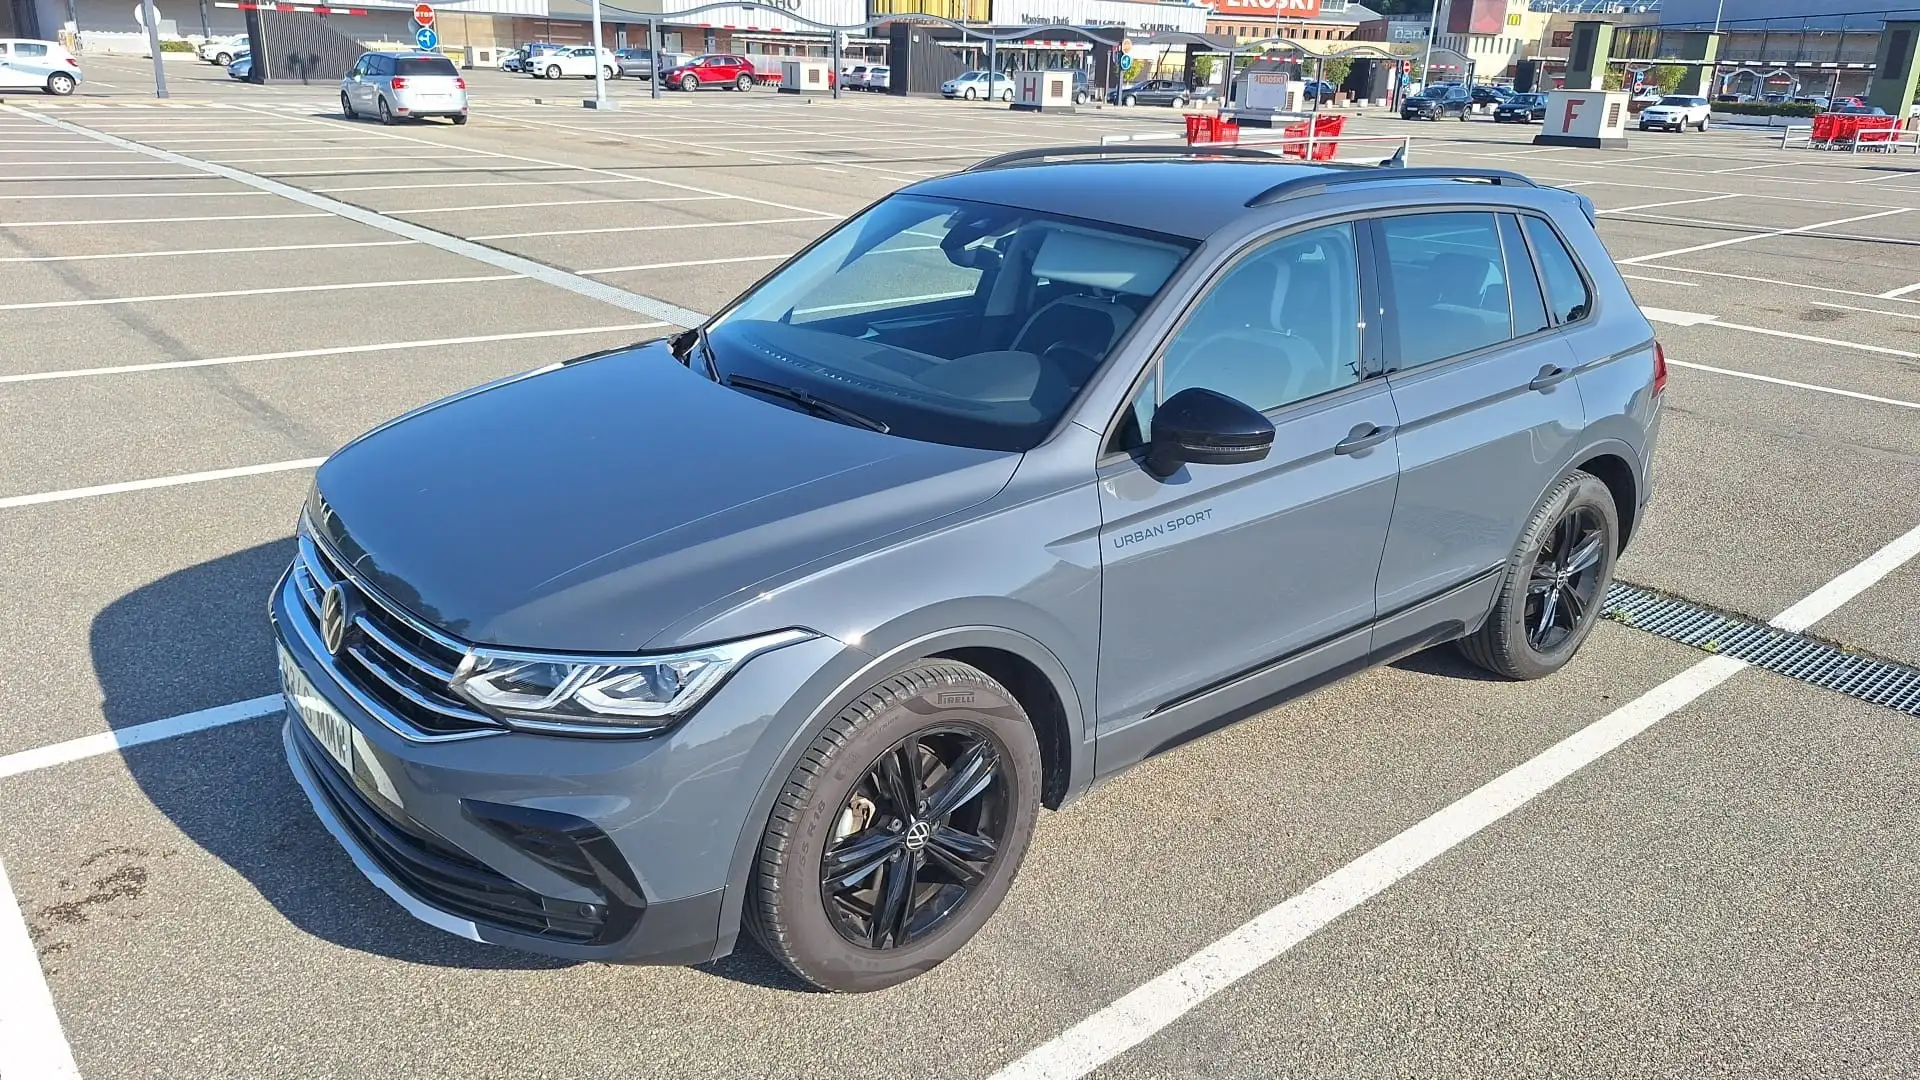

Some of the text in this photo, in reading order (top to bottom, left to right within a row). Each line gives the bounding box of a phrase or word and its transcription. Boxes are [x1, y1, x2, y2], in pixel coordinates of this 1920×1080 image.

[1023, 77, 1036, 102] H
[1562, 99, 1586, 133] F
[1113, 508, 1213, 549] URBAN SPORT
[937, 691, 975, 705] PIRELLI
